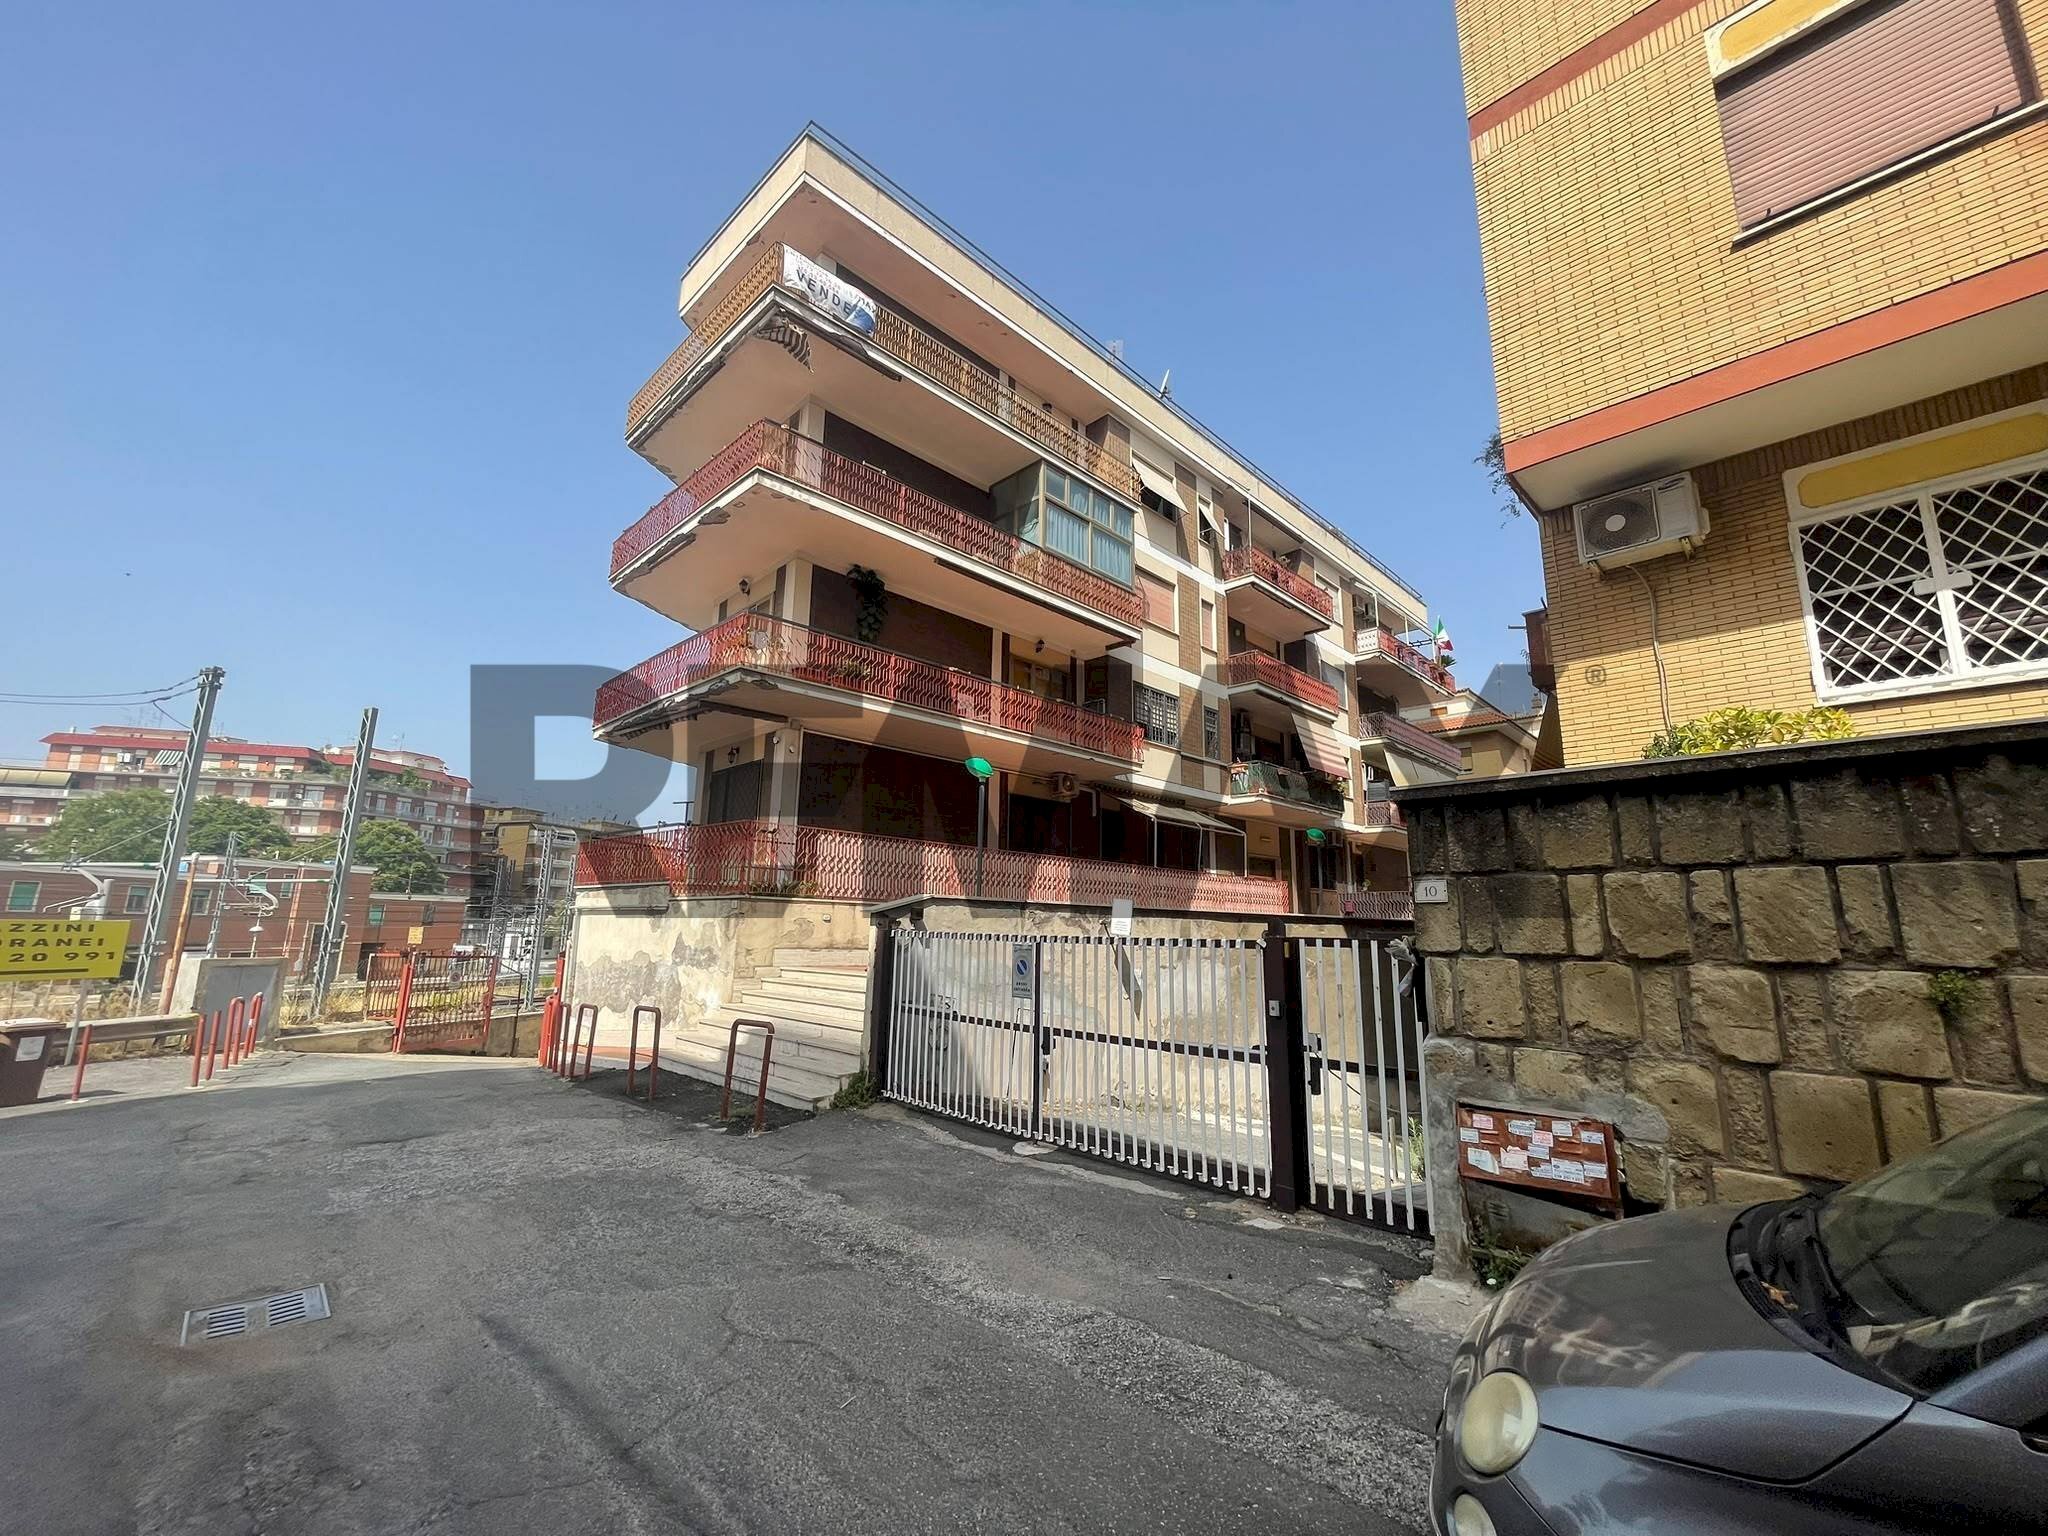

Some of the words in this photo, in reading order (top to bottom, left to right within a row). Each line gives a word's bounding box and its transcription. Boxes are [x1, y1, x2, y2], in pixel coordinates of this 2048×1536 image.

[1425, 886, 1438, 897] 10
[0, 923, 95, 933] ZZINI
[0, 937, 105, 947] RANEI
[64, 951, 116, 961] 991
